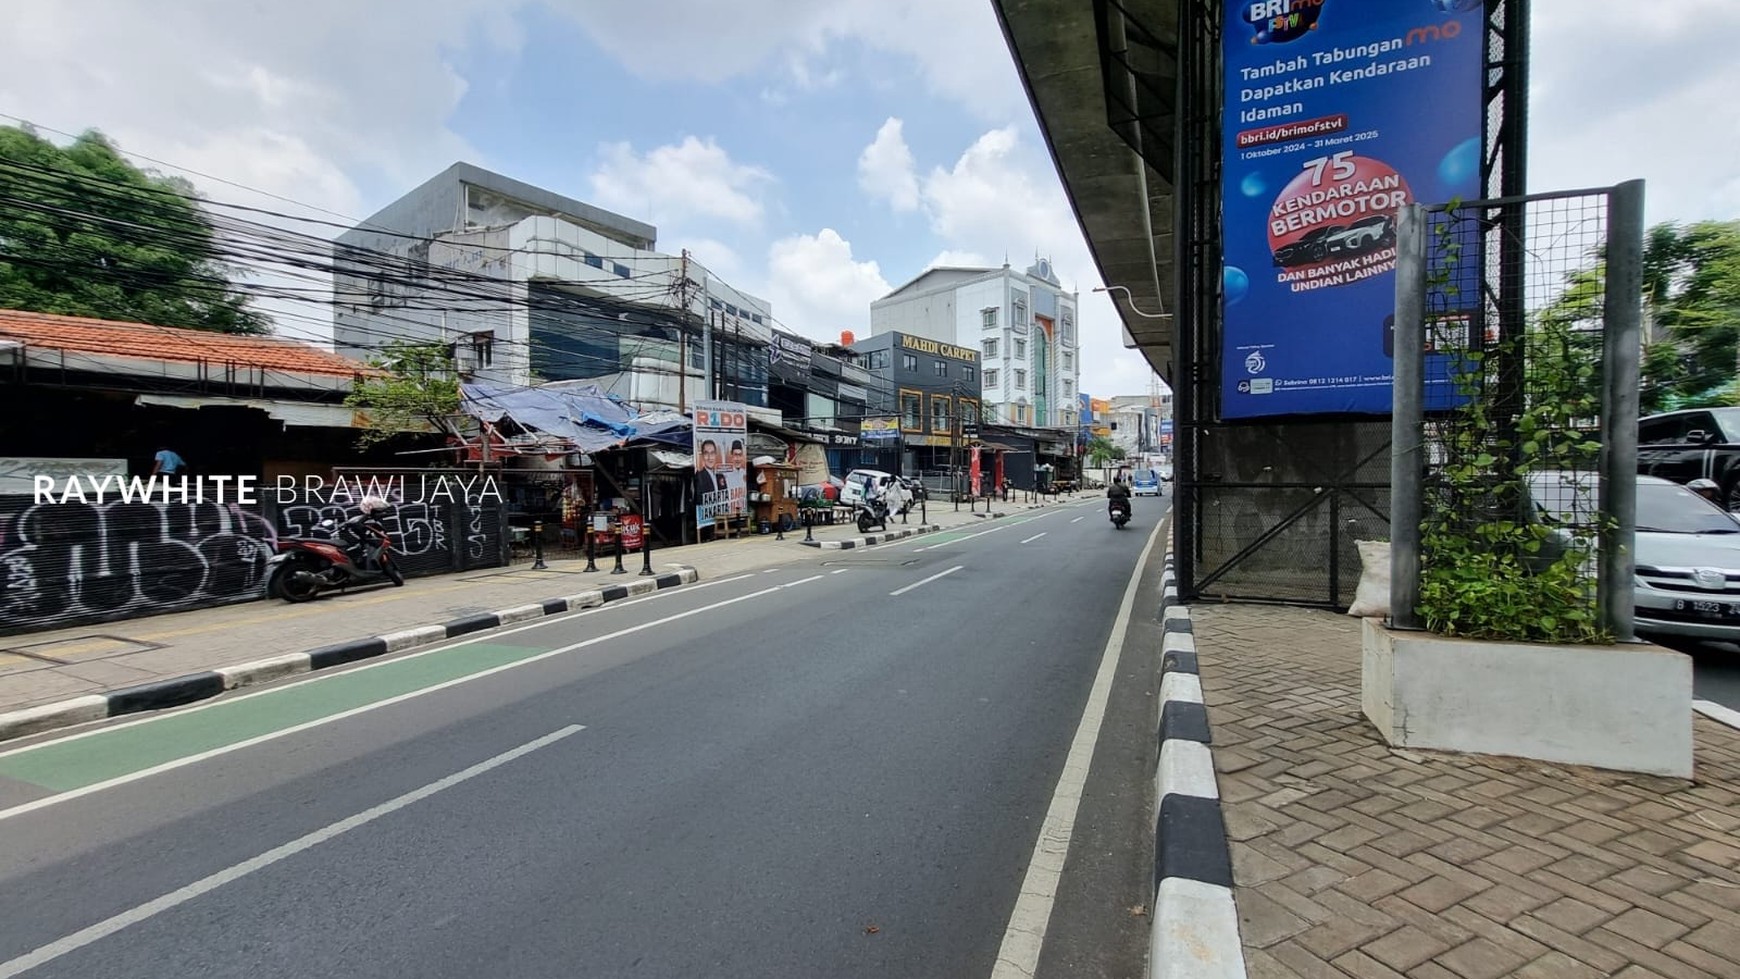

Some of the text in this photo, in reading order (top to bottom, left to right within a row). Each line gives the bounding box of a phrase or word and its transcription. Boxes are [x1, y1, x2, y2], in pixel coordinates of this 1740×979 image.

[1240, 56, 1308, 81] Tambah
[1312, 37, 1402, 67] Tabungan
[1240, 54, 1431, 102] Dapatkan Kendaraan
[1241, 102, 1303, 123] Idaman
[1240, 117, 1343, 145] bbri.id/brimofstvl
[1245, 146, 1282, 160] Oktober
[1283, 142, 1306, 154] 2024
[1314, 140, 1323, 148] 31
[1324, 134, 1353, 147] Maret
[1355, 130, 1379, 142] 2025
[1303, 150, 1356, 187] 75
[1272, 174, 1400, 217] KENDARAAN
[1270, 190, 1408, 237] BERMOTOR
[1277, 270, 1306, 283] DAN
[1307, 258, 1362, 279] BANYAK
[1290, 276, 1348, 292] UNDIAN
[902, 334, 977, 362] MAHDI CARPET
[834, 434, 858, 446] SONY
